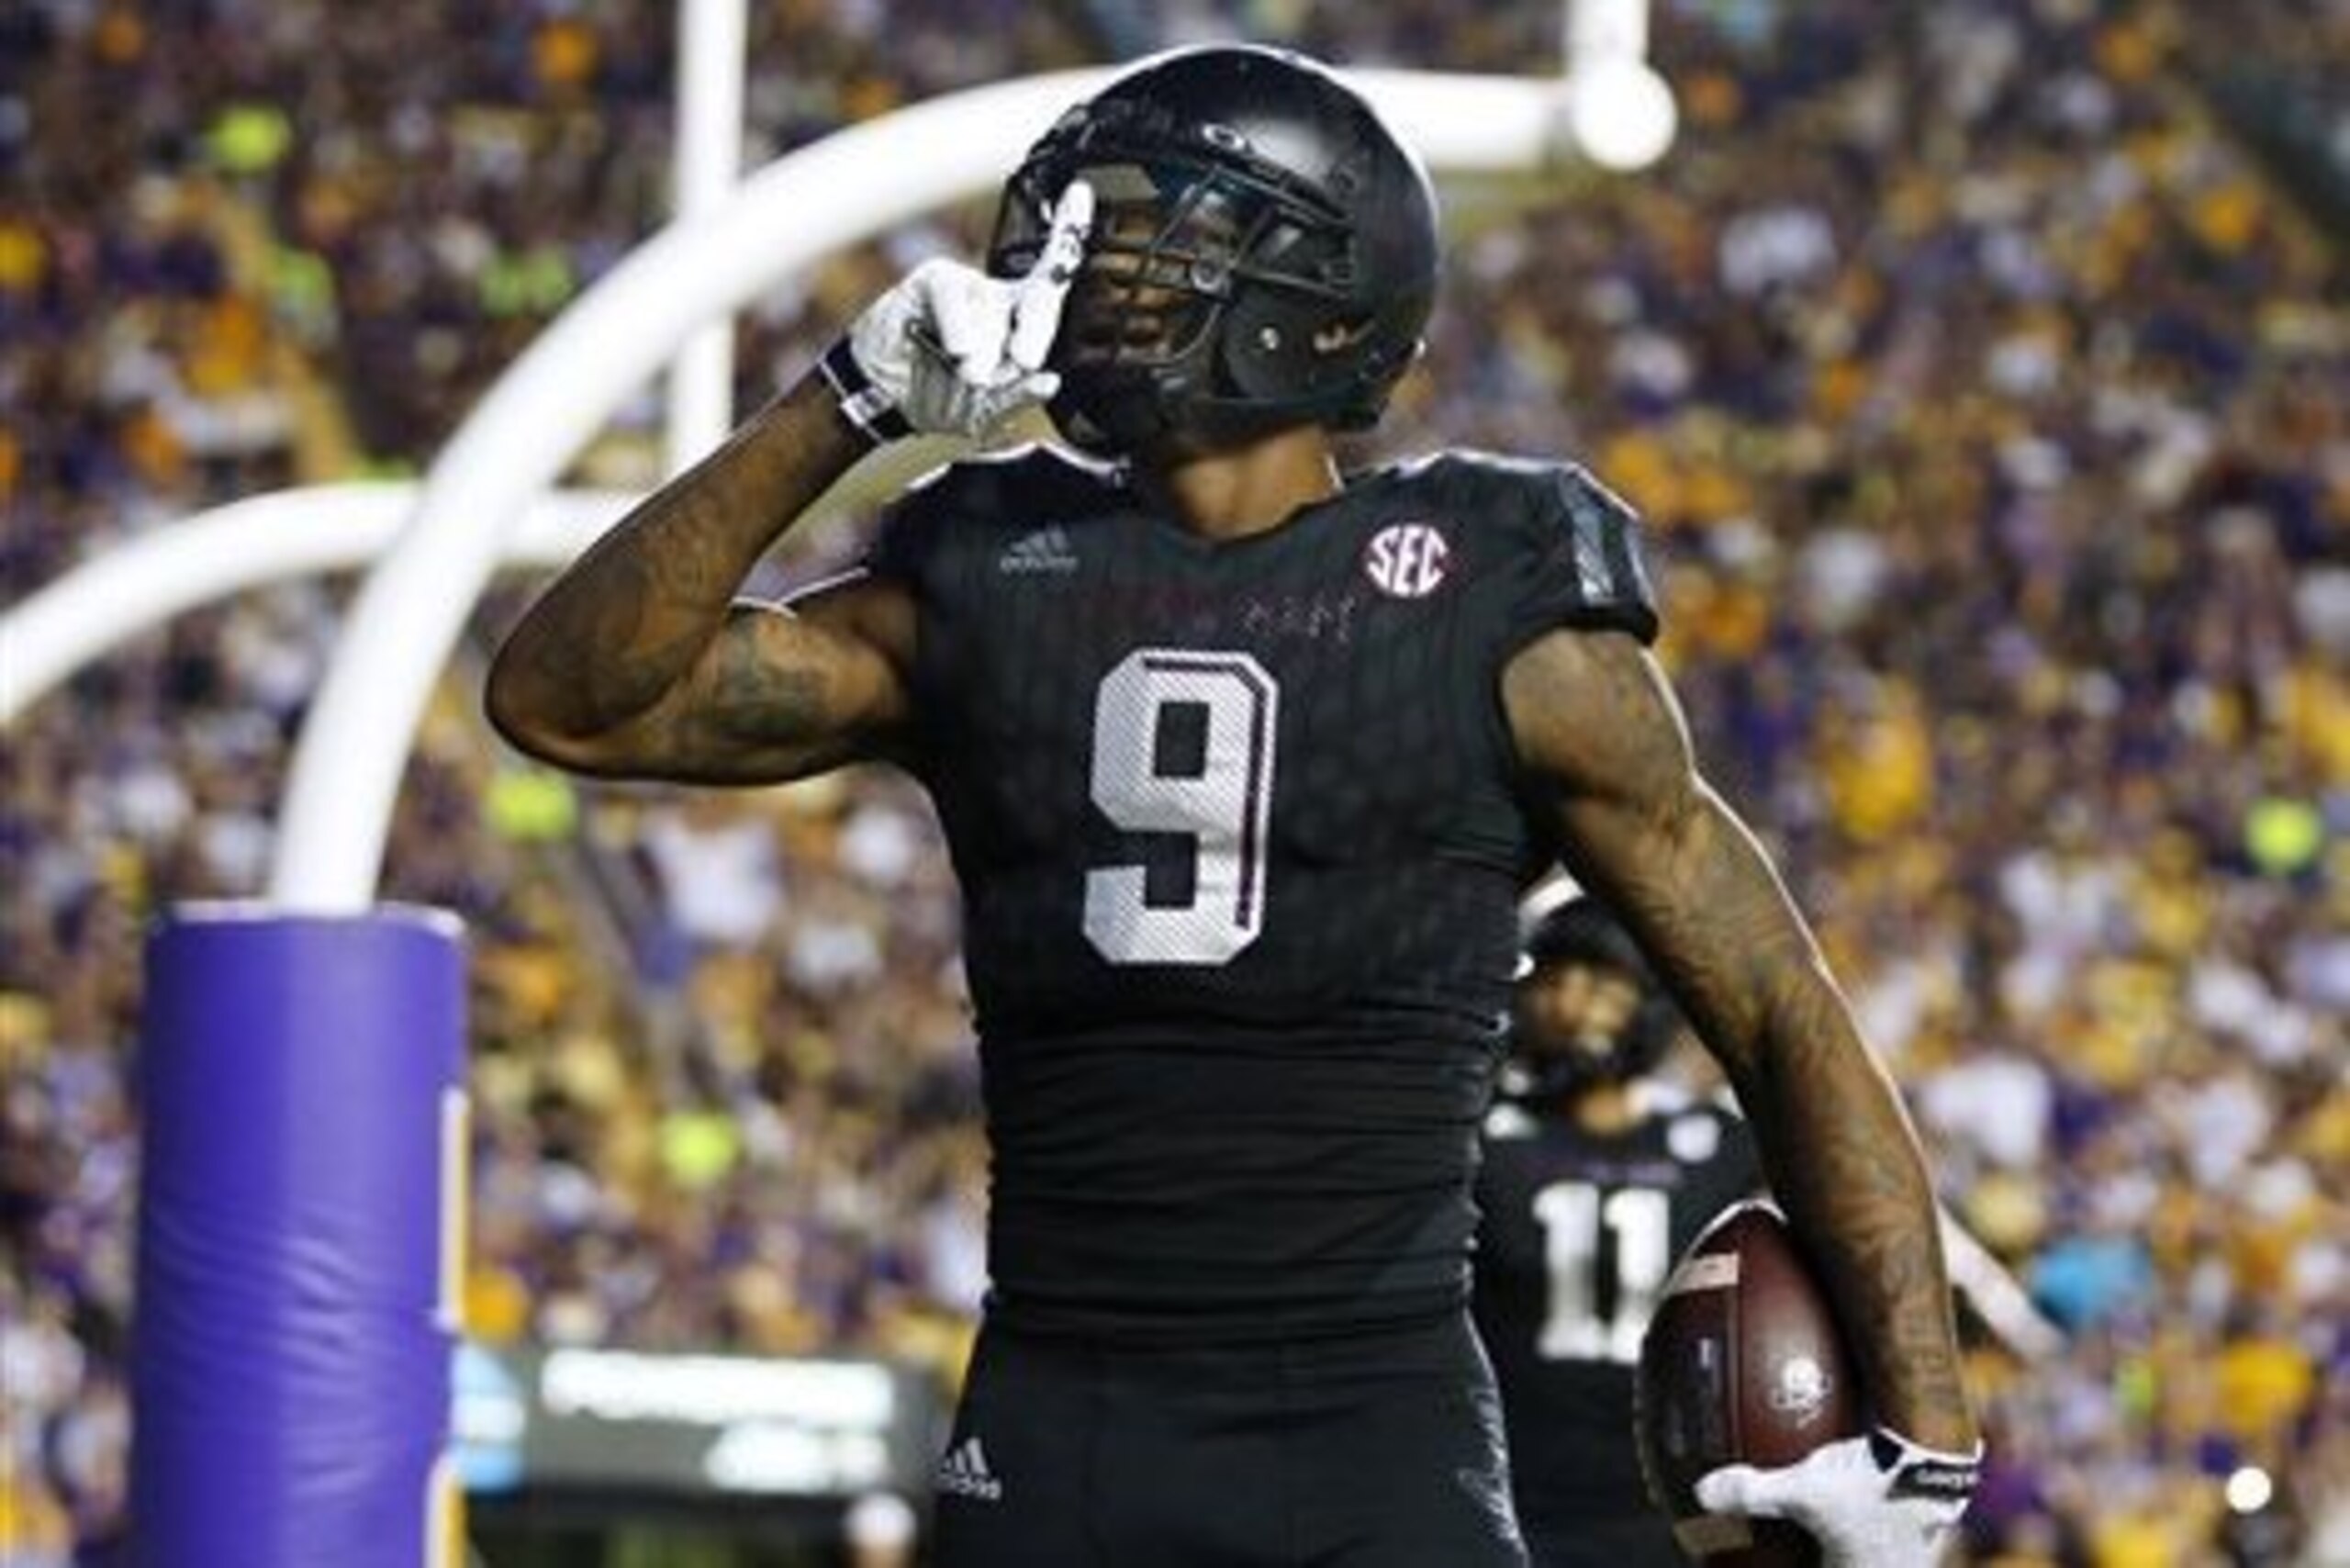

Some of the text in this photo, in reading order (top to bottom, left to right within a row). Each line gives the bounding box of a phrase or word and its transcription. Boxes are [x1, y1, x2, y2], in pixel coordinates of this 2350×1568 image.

[1368, 524, 1449, 598] SEC
[1083, 647, 1278, 964] 9
[1533, 1181, 1669, 1362] 11
